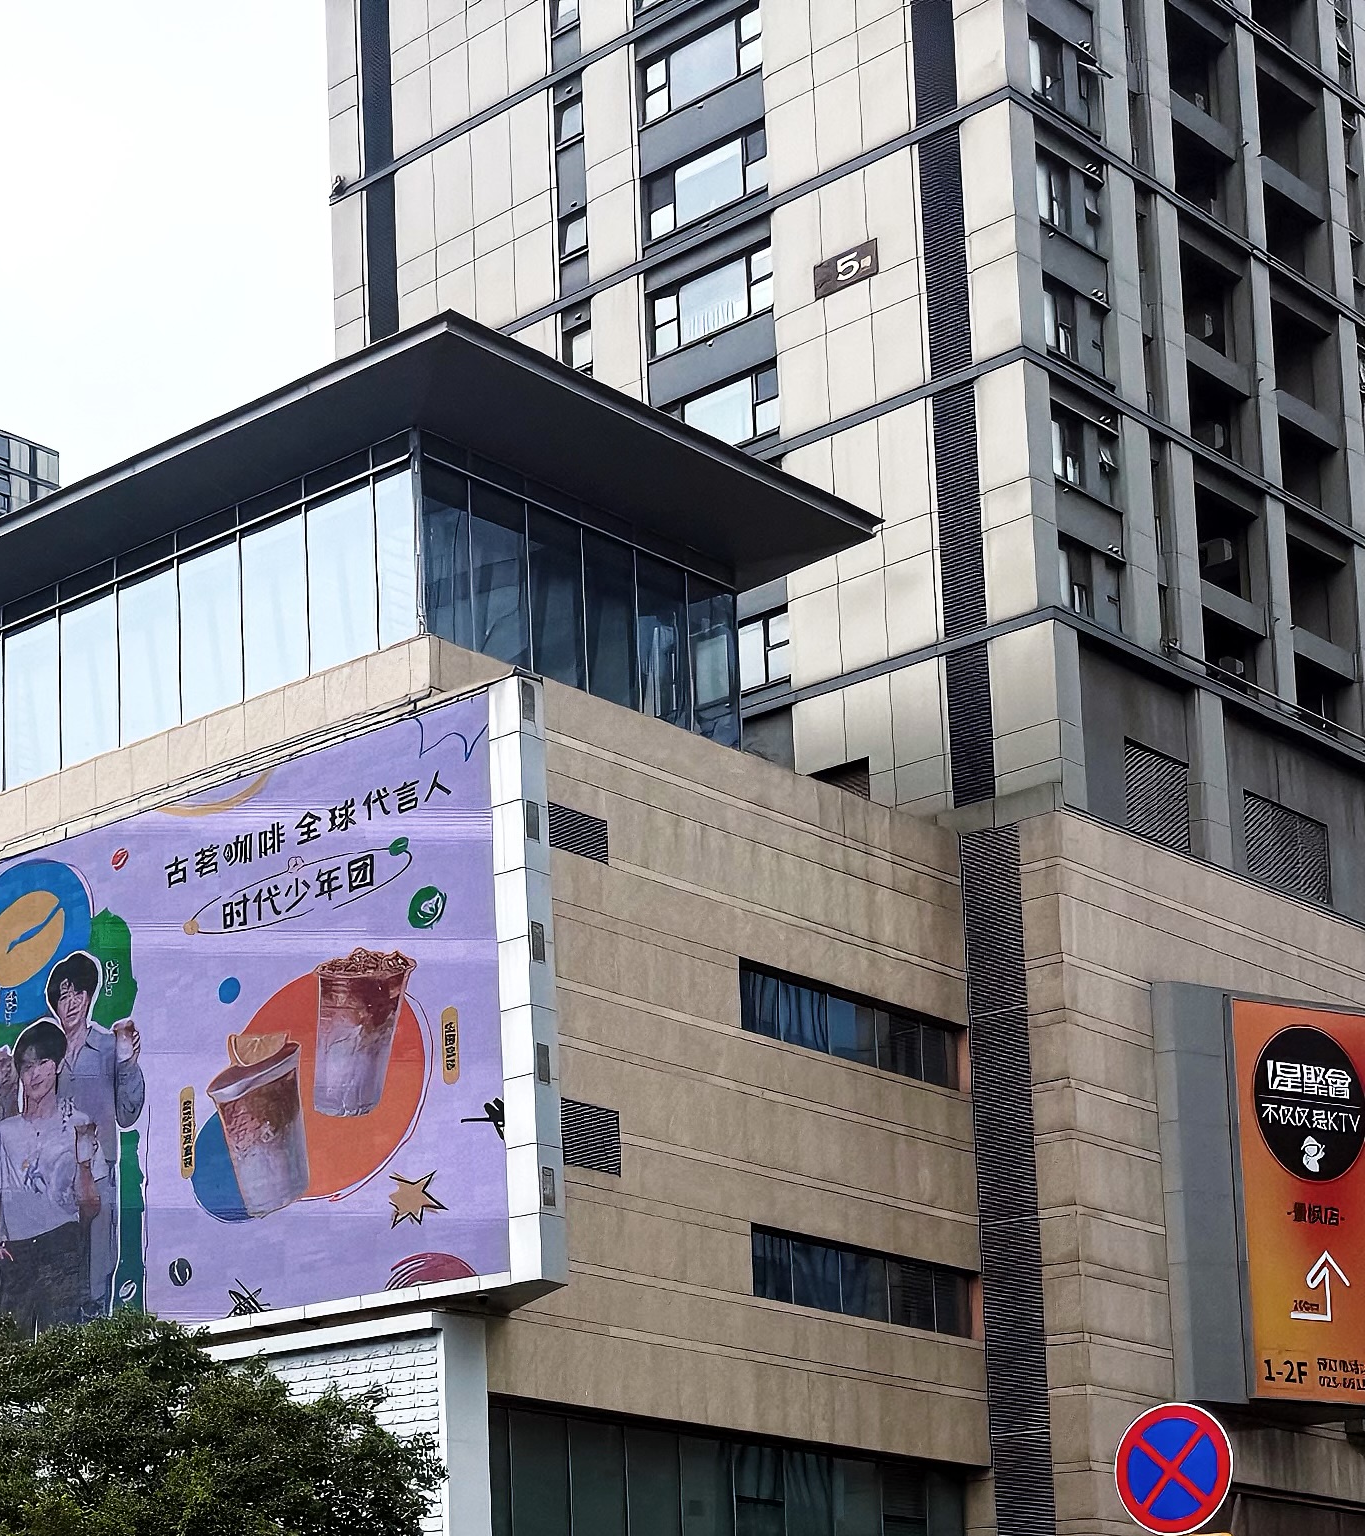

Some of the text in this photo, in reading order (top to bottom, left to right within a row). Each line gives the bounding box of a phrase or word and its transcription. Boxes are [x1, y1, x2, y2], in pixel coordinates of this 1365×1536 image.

[836, 251, 860, 281] 5
[165, 770, 452, 889] 古茗咖啡全球代言人
[222, 854, 375, 930] 时代少年团
[1263, 1358, 1308, 1384] 1-2F
